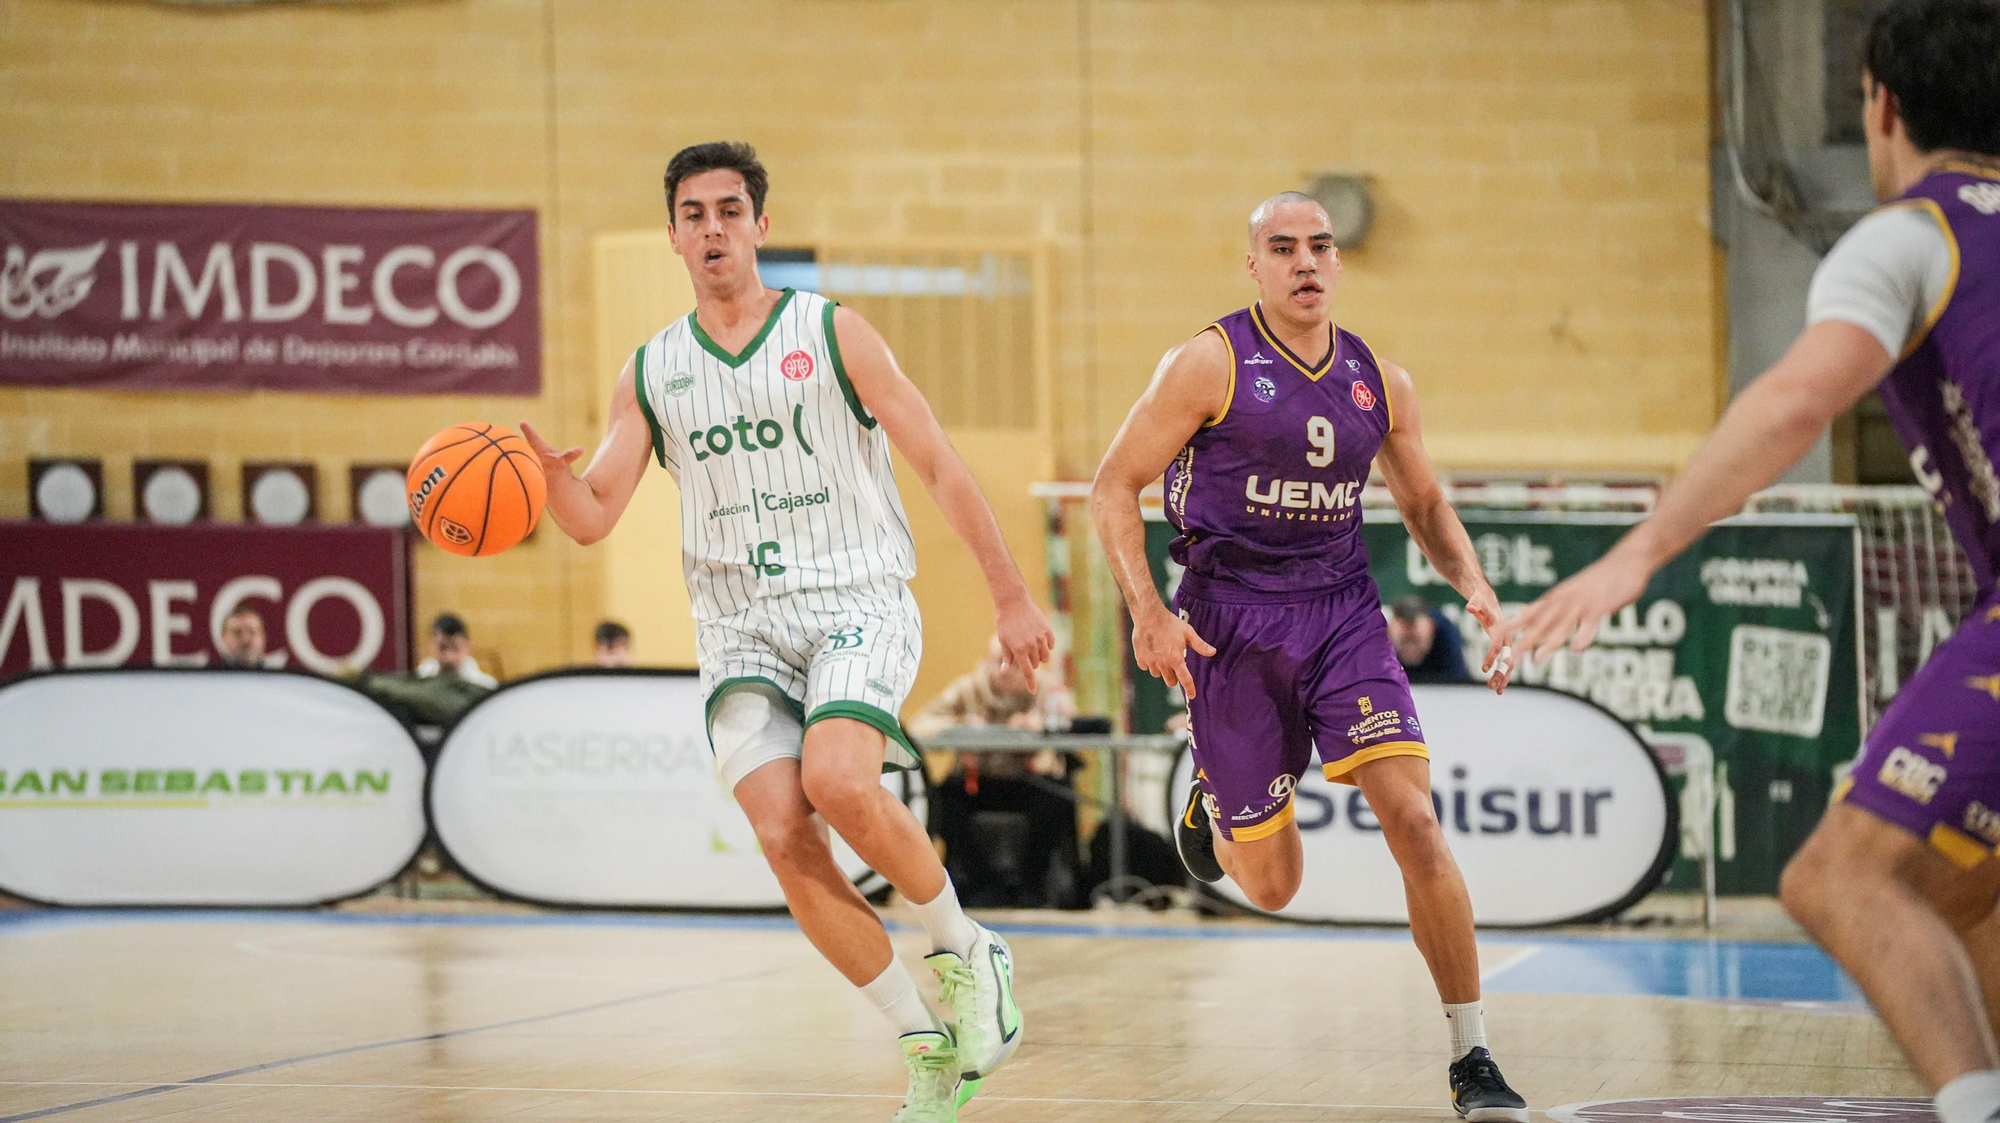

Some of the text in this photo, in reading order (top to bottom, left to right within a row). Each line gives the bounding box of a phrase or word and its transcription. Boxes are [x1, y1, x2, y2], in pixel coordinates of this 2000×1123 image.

[119, 241, 521, 328] IMDECO
[689, 415, 784, 461] coto
[1306, 415, 1335, 468] 9
[761, 486, 830, 513] Cajasol
[1245, 475, 1360, 510] UEMC
[1246, 505, 1354, 522] UNIVERSIDA
[1349, 710, 1399, 732] ALIMENTOS
[1359, 718, 1401, 735] VALLADOLID
[0, 769, 390, 795] AN SEBASTIAN
[1231, 811, 1263, 820] MERCURY
